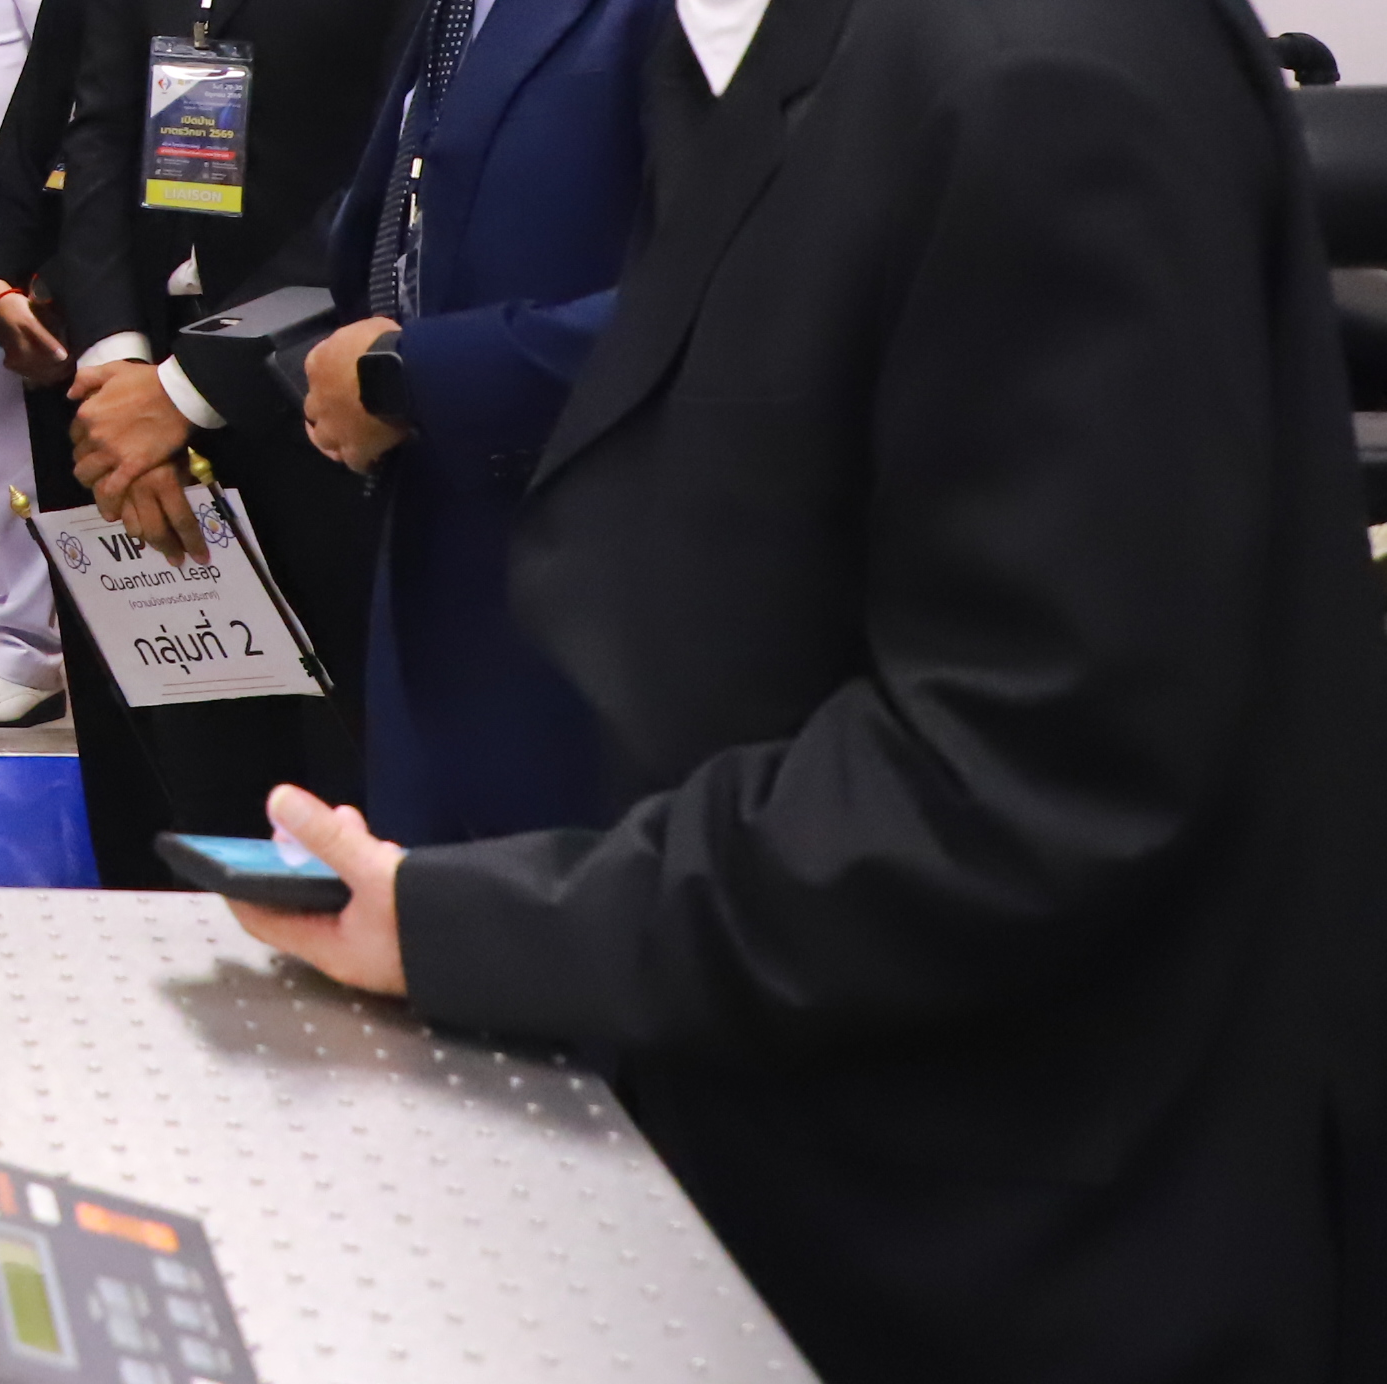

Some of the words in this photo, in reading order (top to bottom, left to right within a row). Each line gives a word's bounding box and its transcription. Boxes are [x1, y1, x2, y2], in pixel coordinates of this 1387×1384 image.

[208, 128, 235, 139] 2569
[164, 187, 222, 203] LIAISON
[98, 532, 146, 562] VIP
[100, 571, 176, 592] Quantum
[178, 565, 221, 584] Leap
[134, 609, 228, 675] กลุ่มที่
[229, 619, 264, 656] 2
